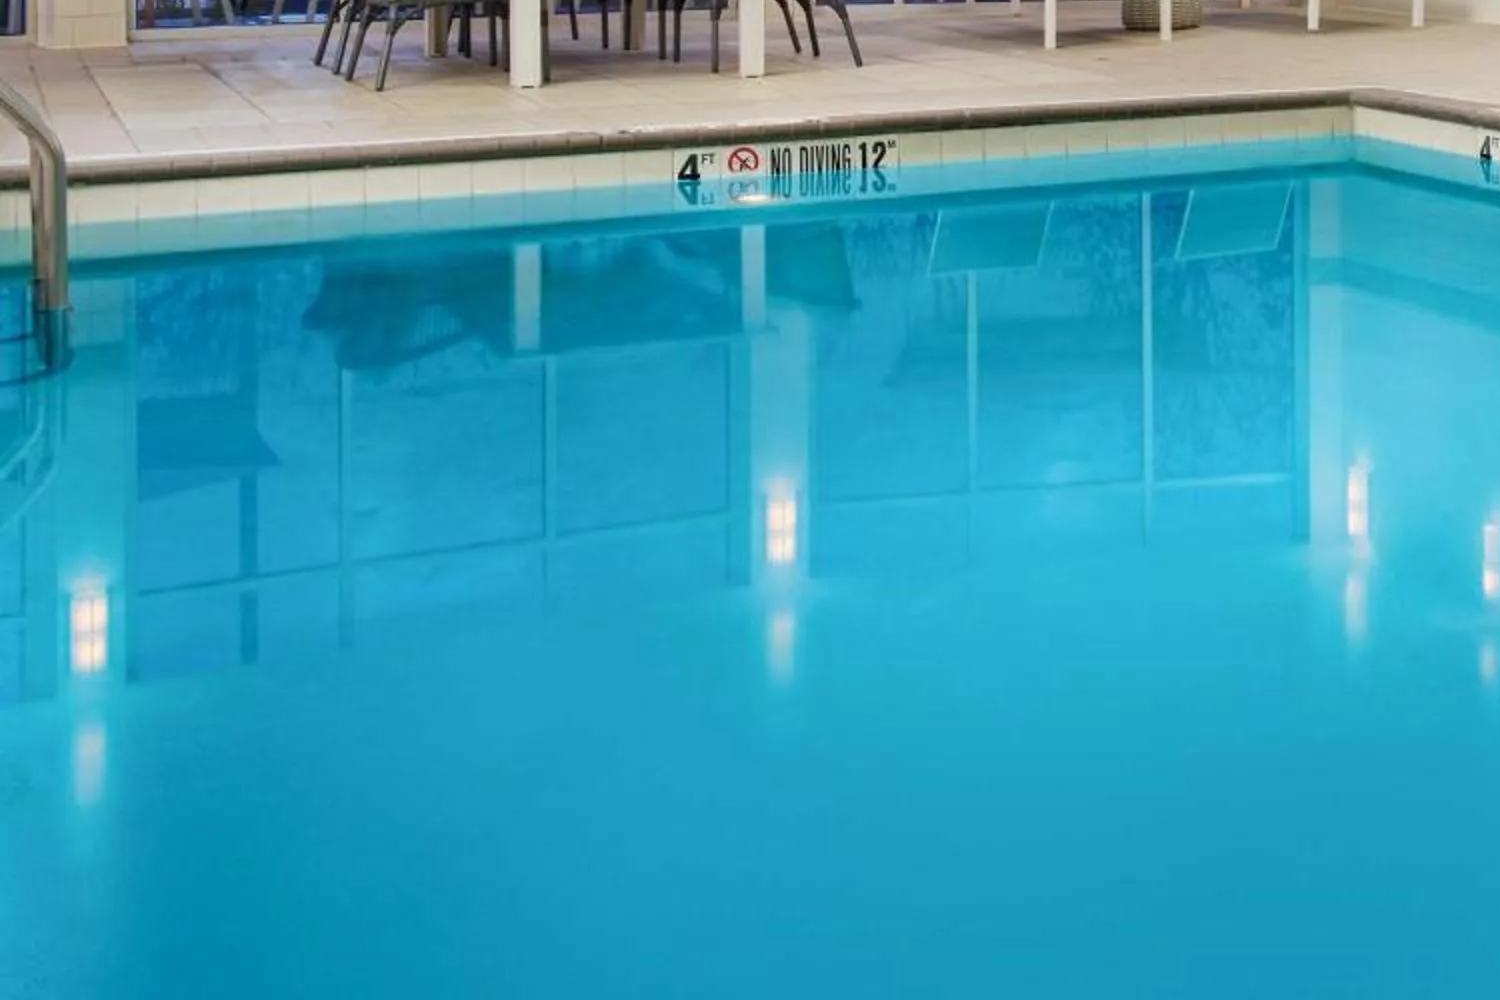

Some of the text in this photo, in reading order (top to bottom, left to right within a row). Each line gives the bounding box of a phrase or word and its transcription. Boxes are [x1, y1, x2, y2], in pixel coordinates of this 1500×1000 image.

[770, 147, 792, 175] NO
[799, 143, 851, 173] DIVING
[1480, 135, 1492, 159] 4
[678, 152, 715, 181] 4 FT
